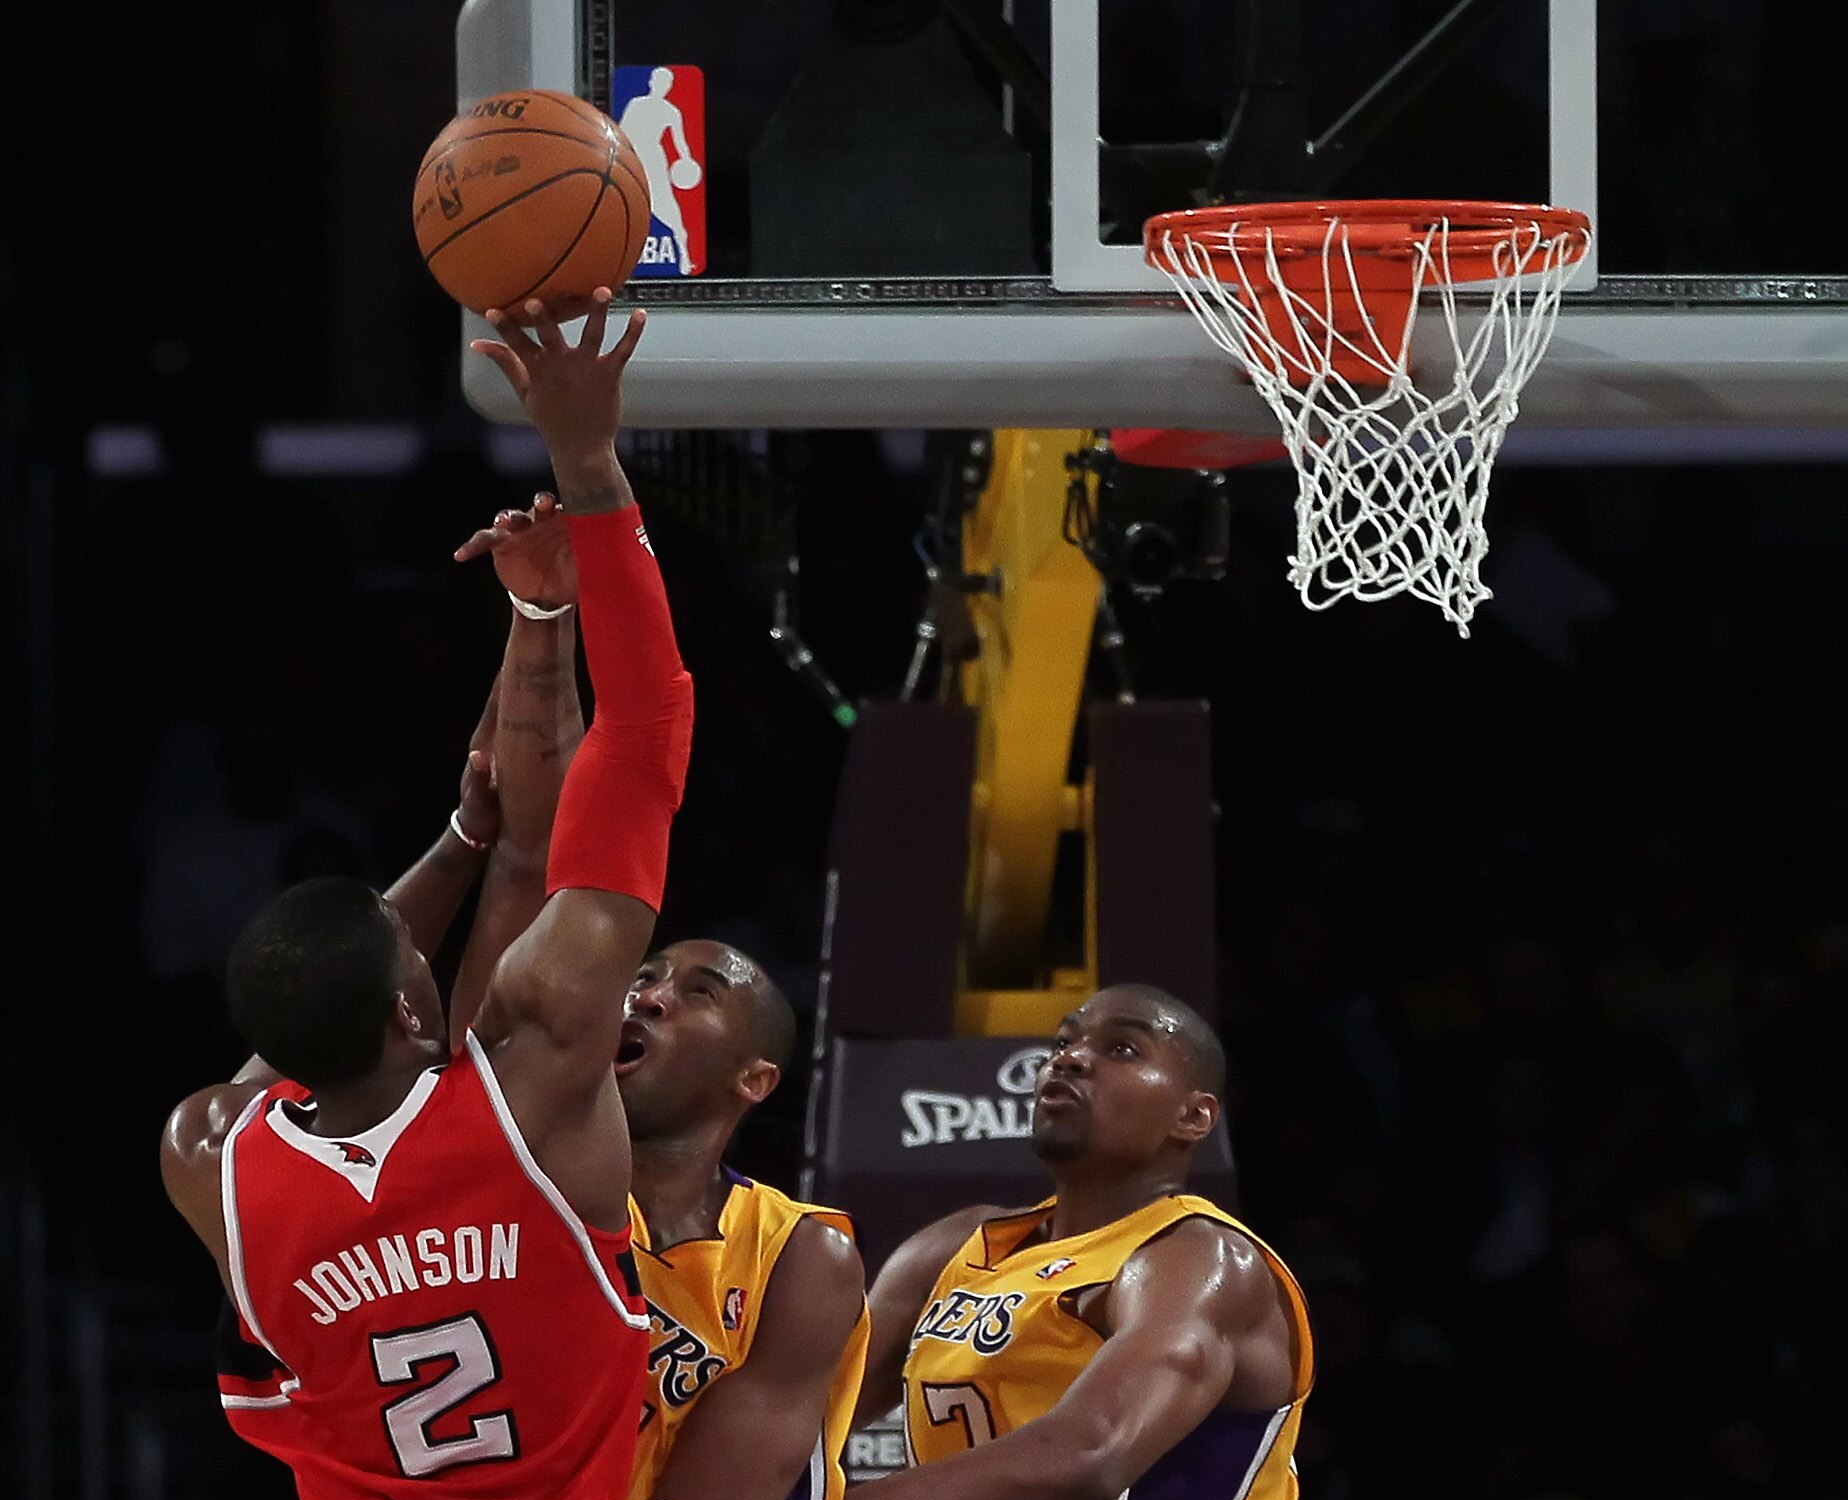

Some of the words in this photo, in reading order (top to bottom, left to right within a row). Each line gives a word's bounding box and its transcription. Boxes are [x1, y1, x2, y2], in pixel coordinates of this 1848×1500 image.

[637, 236, 676, 264] BA
[902, 1089, 1035, 1147] SPAL
[293, 1223, 519, 1325] JOHNSON
[370, 1310, 523, 1479] 2
